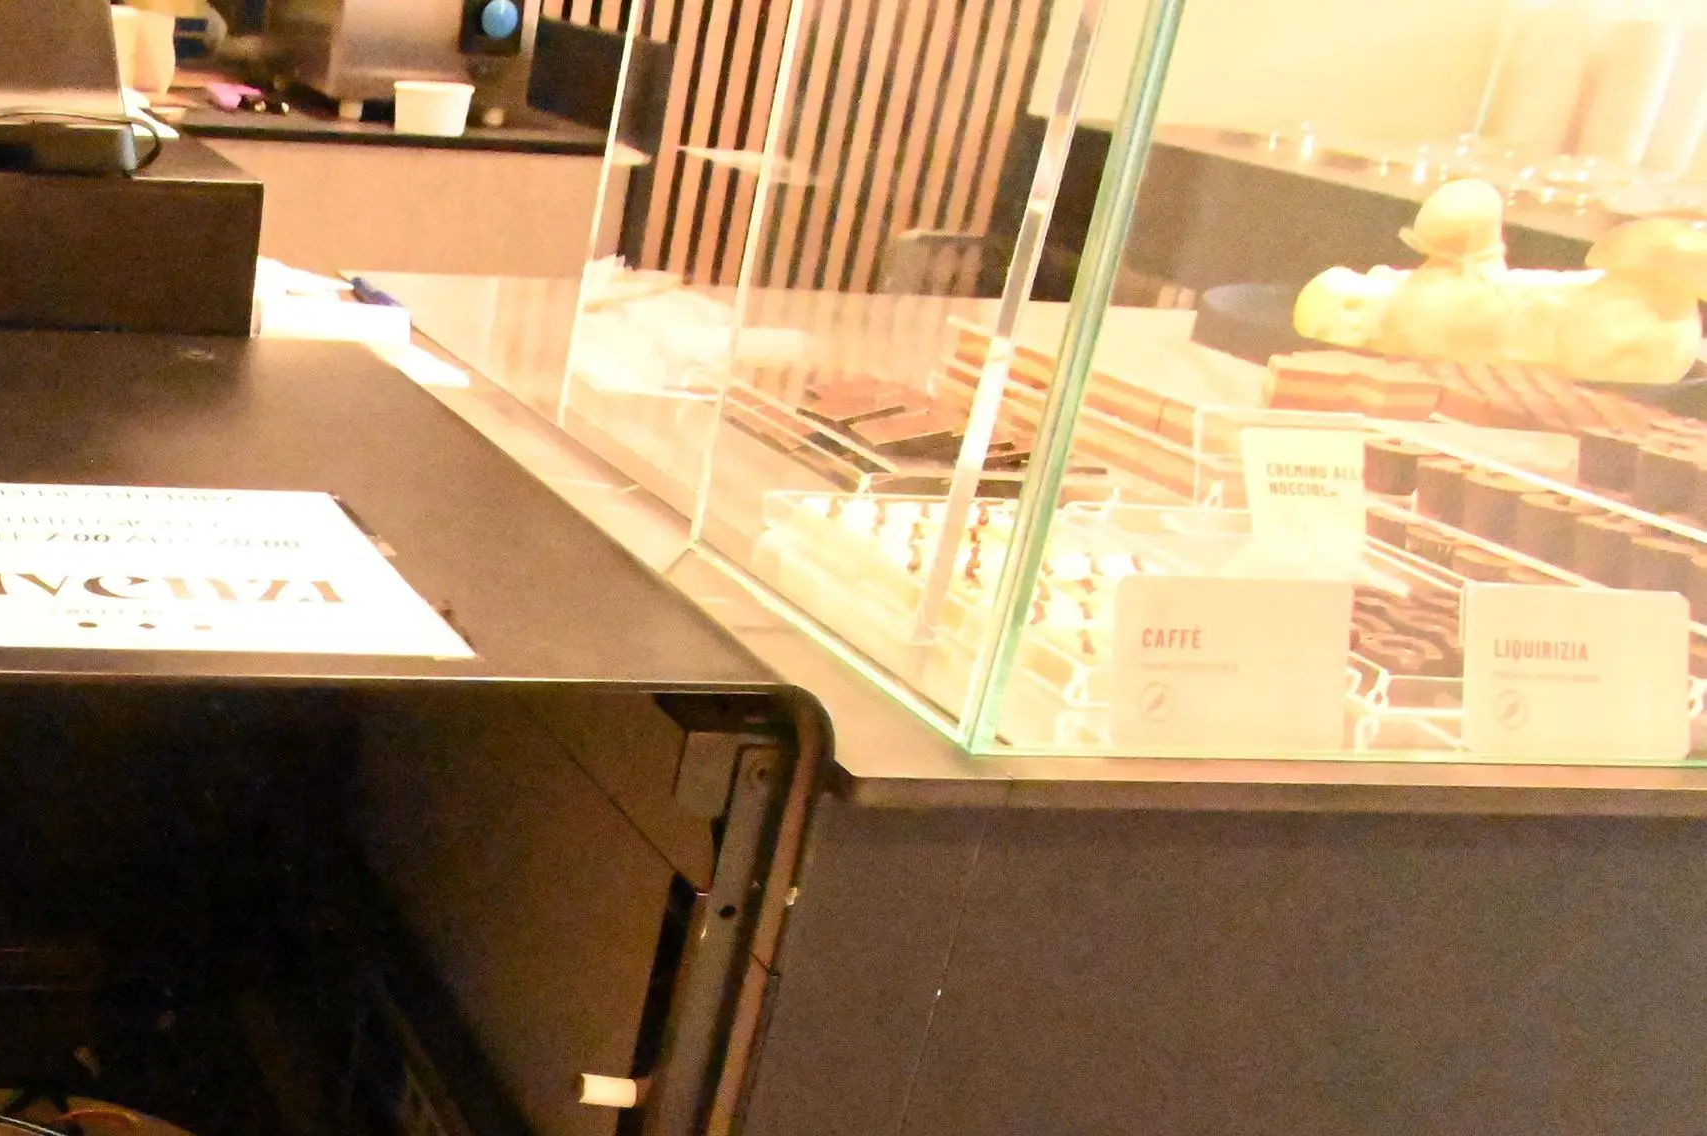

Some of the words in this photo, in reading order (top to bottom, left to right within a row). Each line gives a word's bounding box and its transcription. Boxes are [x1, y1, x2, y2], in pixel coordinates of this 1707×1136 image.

[1333, 465, 1363, 481] ALL
[1141, 623, 1202, 650] CAFFÈ
[1493, 638, 1590, 662] LIQUIRIZIA
